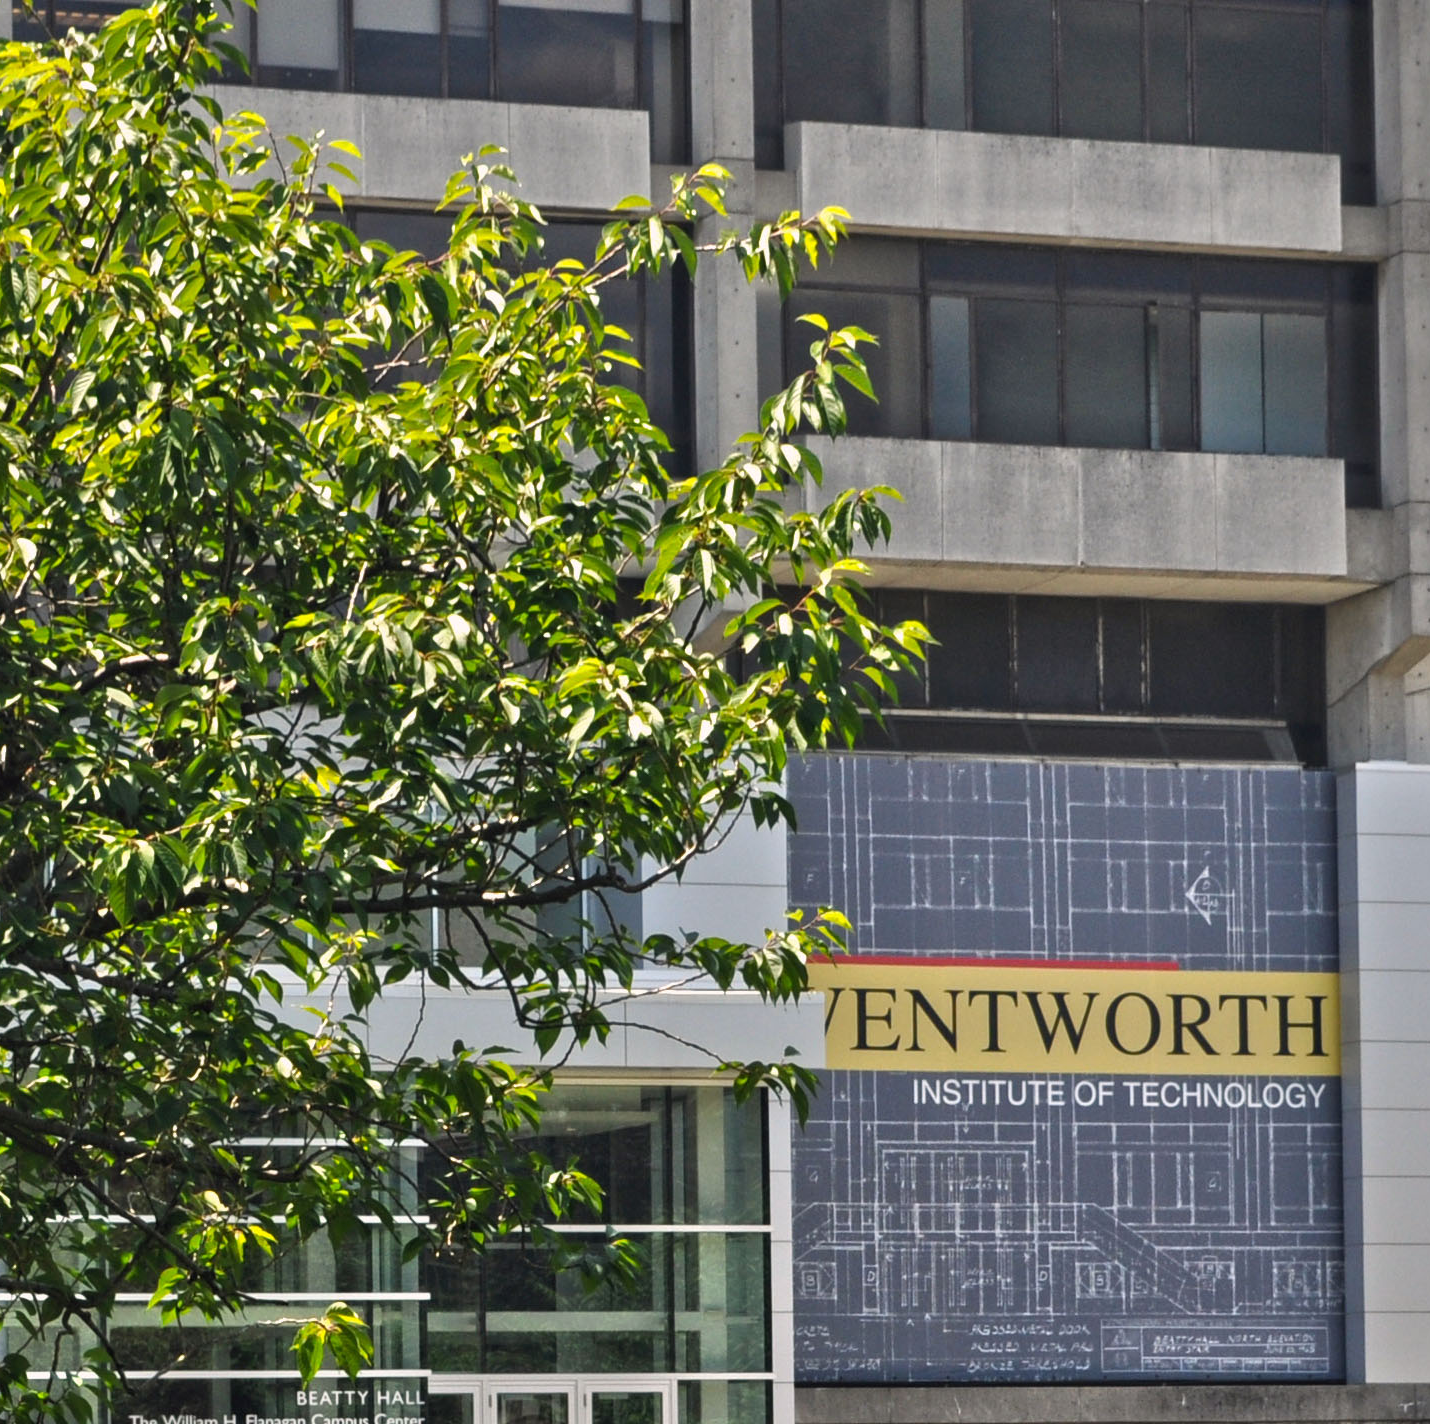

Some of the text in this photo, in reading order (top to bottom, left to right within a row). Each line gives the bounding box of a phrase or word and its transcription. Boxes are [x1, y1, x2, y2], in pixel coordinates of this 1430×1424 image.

[913, 1079, 1327, 1109] INSTITUTE OF TECHNOLOGY
[296, 1390, 425, 1405] BEATTY HALL
